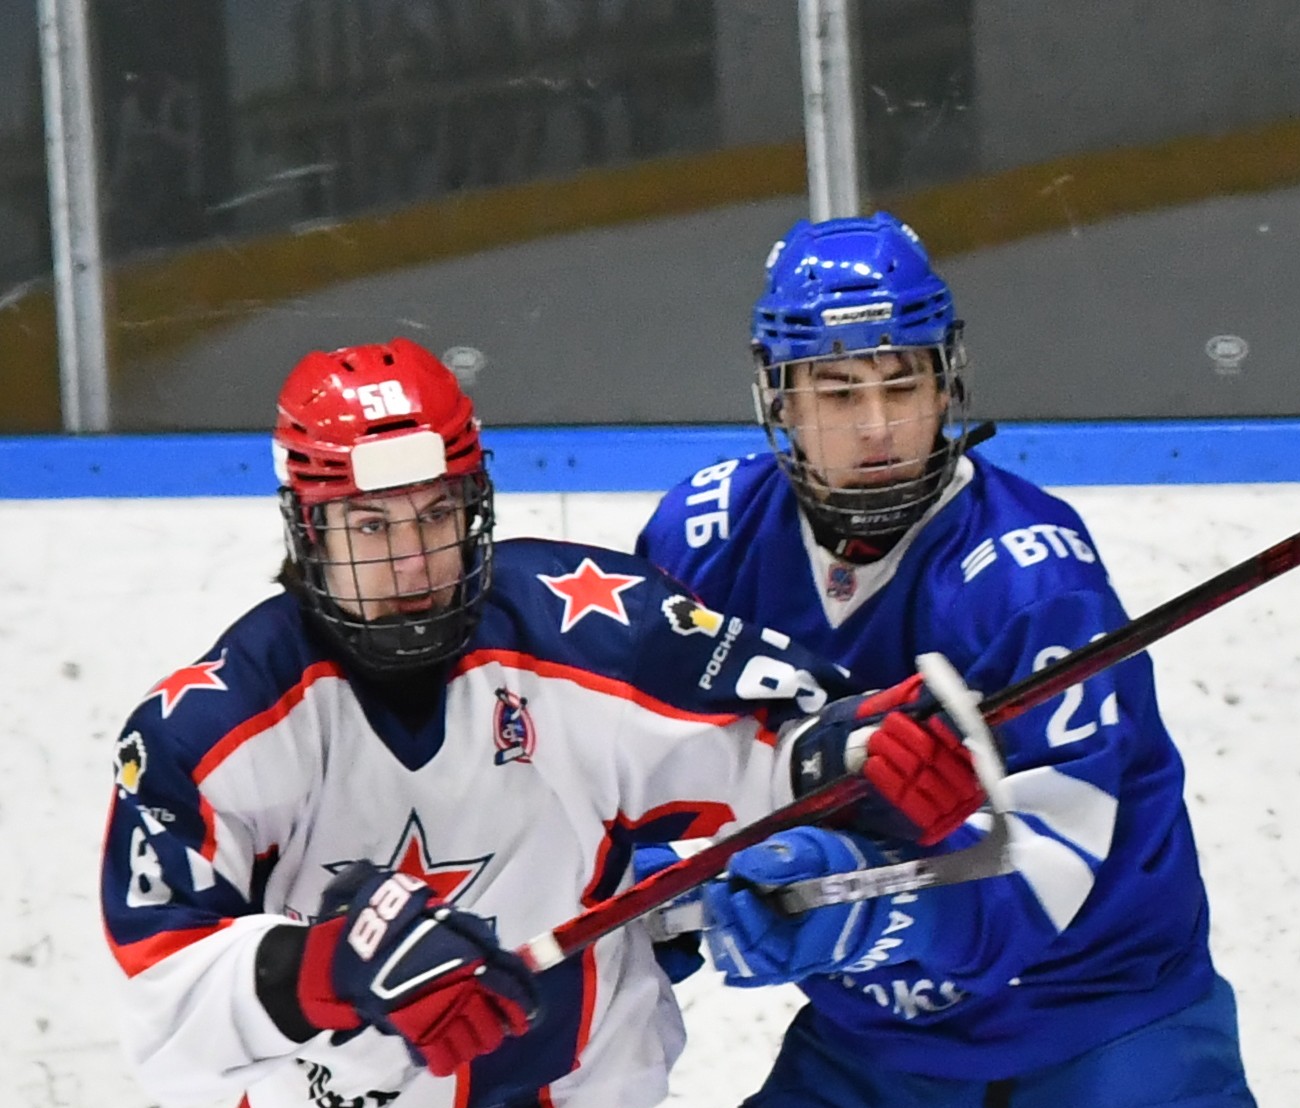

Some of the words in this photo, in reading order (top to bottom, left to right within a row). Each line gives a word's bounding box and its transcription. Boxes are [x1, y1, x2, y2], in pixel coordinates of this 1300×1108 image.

[685, 458, 740, 549] ВТБ
[1000, 523, 1096, 568] ВТБ
[347, 872, 429, 962] BAU
